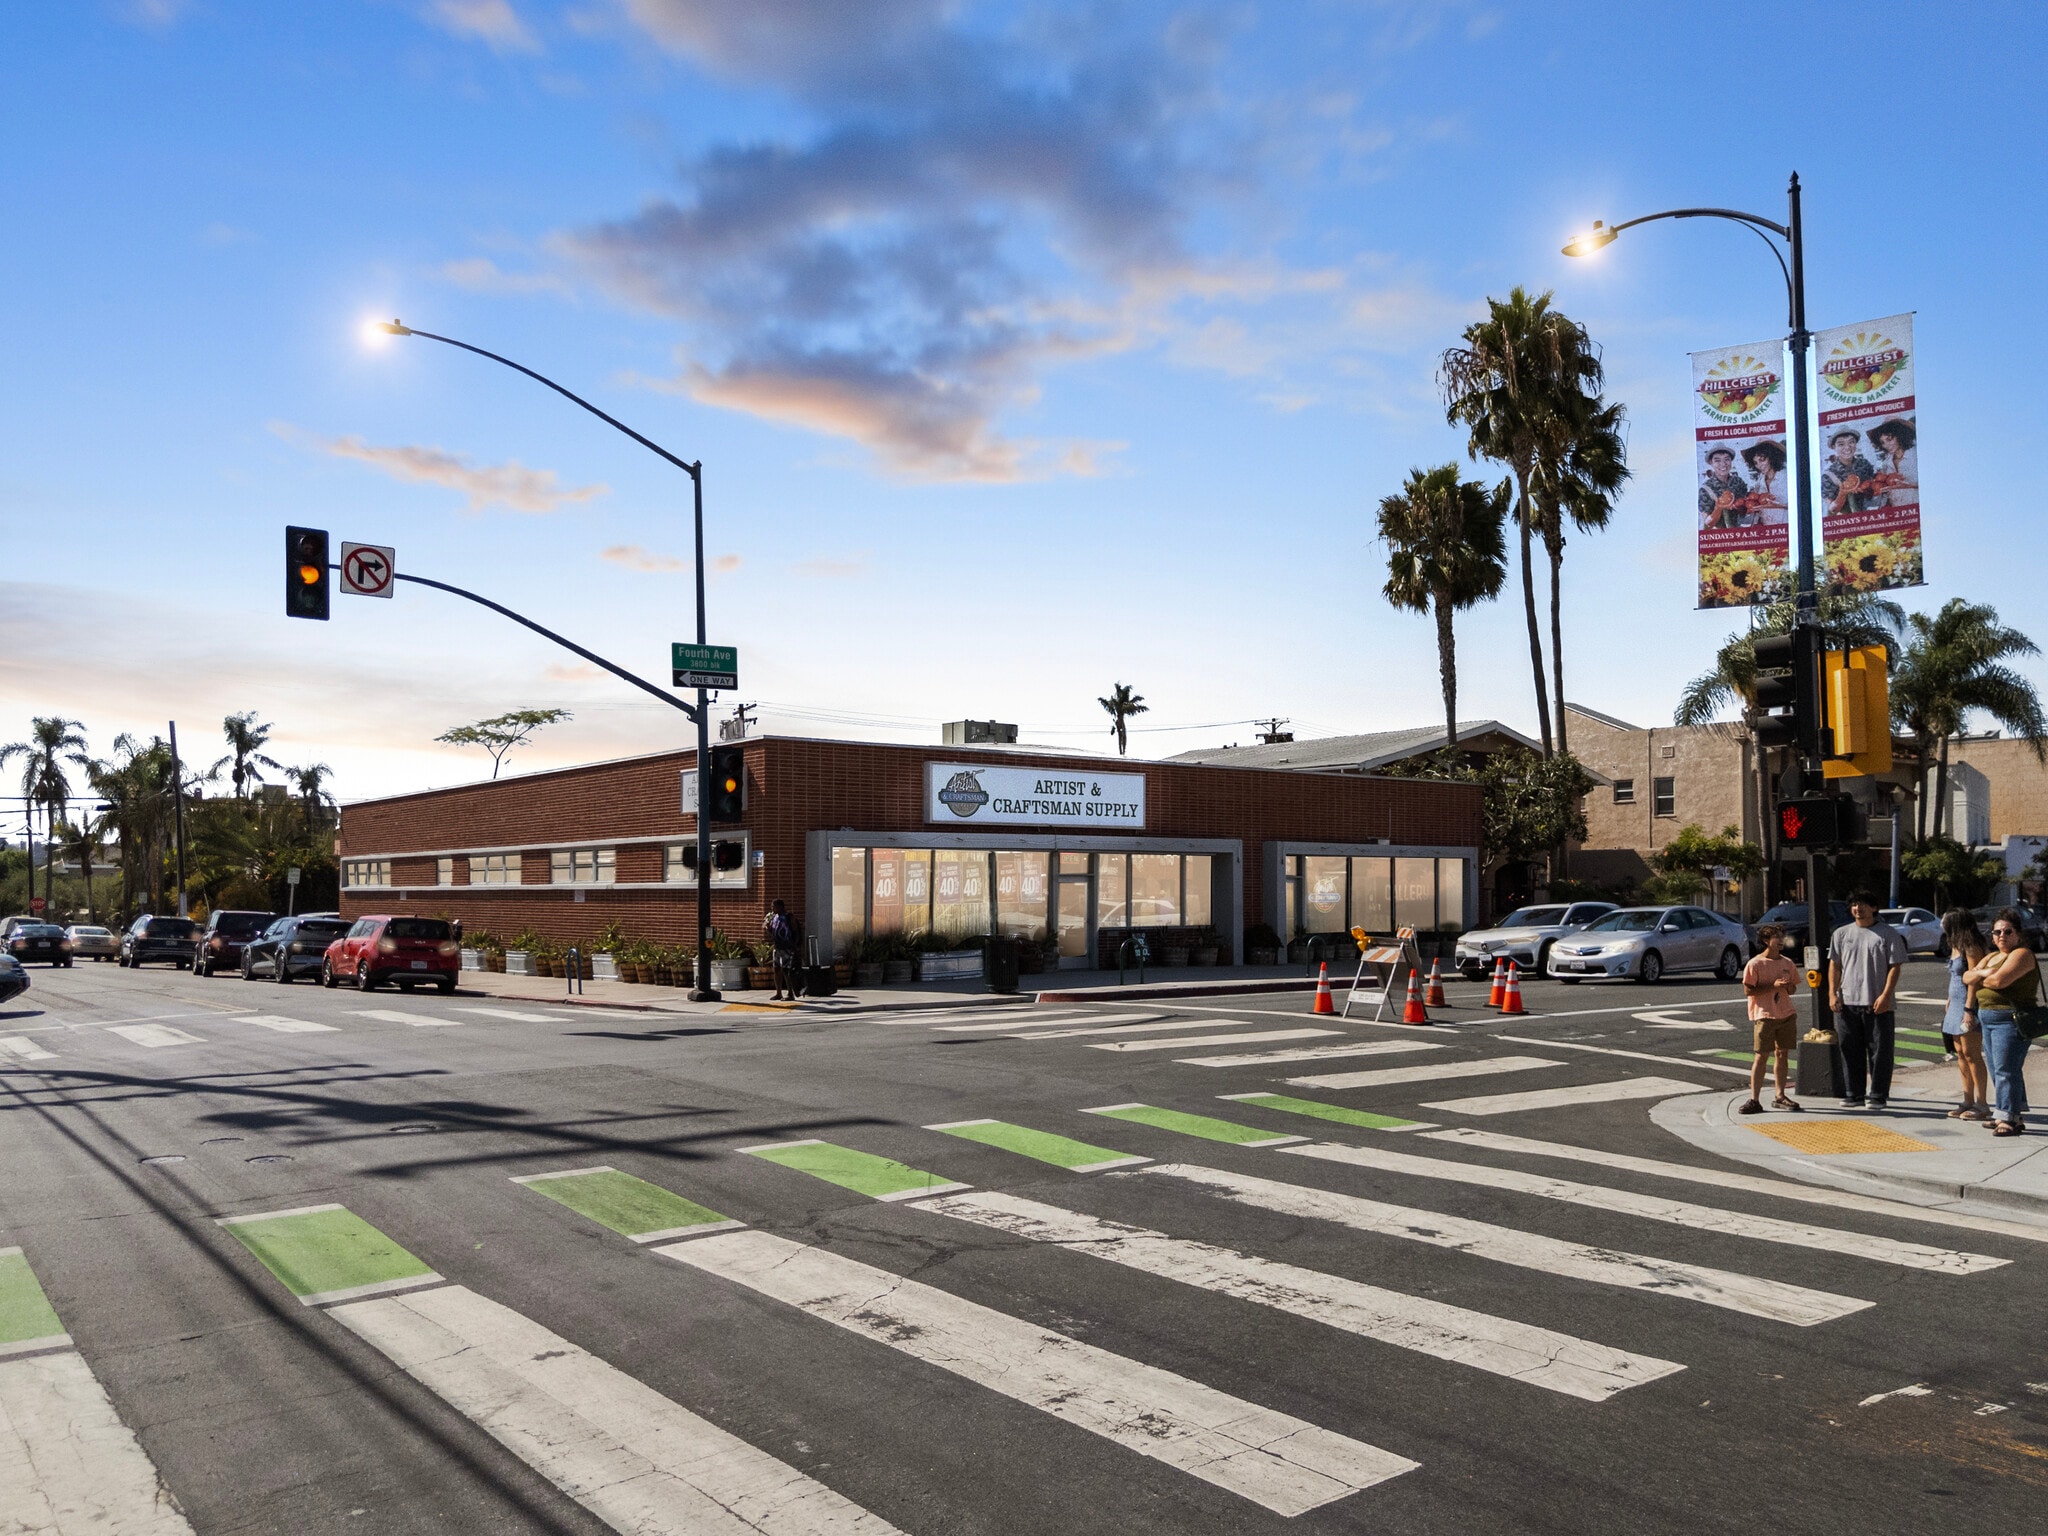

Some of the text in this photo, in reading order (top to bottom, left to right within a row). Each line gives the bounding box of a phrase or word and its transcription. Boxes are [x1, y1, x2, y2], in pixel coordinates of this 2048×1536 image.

[1827, 351, 1898, 372] HILLCREST
[1704, 374, 1772, 391] HILLCREST
[1824, 375, 1901, 404] FARMERS MARKET
[1701, 398, 1773, 424] FARMERS MARKET
[1826, 411, 1847, 421] FRESH
[1854, 407, 1874, 416] LOCAL
[1875, 401, 1905, 412] PRODUCE
[1704, 429, 1723, 437] FRESH
[1730, 427, 1748, 436] LOCAL
[1749, 424, 1777, 434] PRODUCE
[1823, 516, 1861, 528] SUNDAYS
[1869, 513, 1887, 521] A.M.
[1901, 508, 1918, 517] P.M.
[1699, 532, 1734, 541] SUNDAYS
[678, 646, 731, 660] Fourth Ave
[690, 660, 720, 669] 3800 blk
[690, 675, 731, 685] ONE WAY
[1034, 780, 1102, 796] ARTIST &
[950, 793, 985, 802] CRAFTSMAN
[992, 798, 1084, 816] CRAFTSMAN
[1085, 802, 1139, 818] SUPPLY
